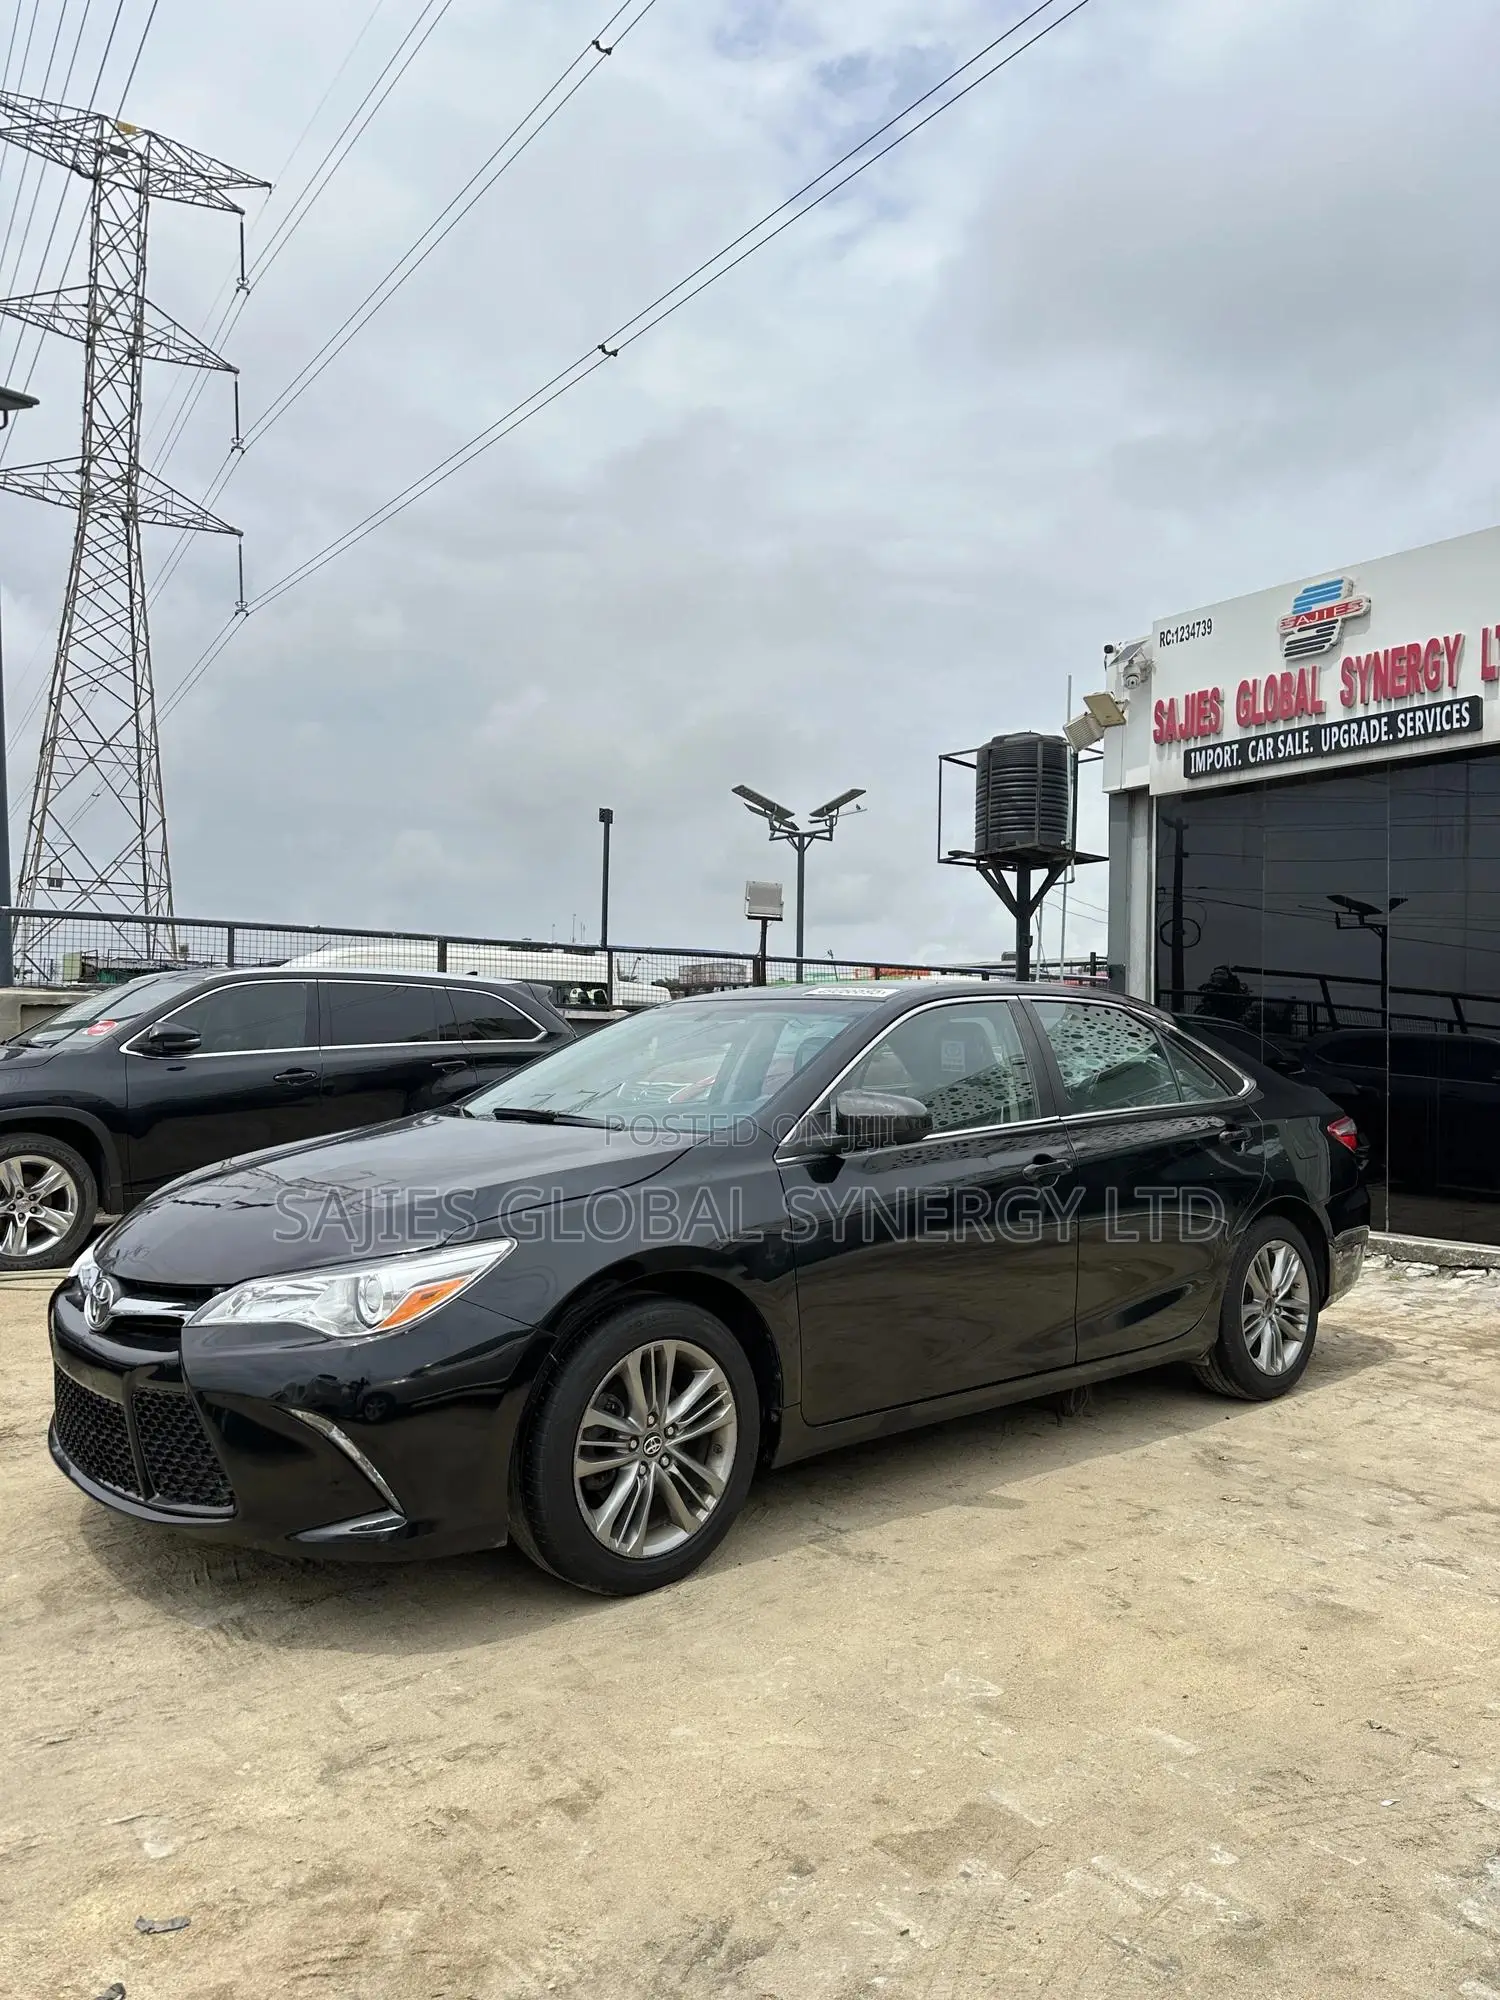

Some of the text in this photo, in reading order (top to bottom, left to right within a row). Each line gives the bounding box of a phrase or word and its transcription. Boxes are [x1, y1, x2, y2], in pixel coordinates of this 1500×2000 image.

[1159, 618, 1213, 648] RC:1234739
[1280, 598, 1364, 631] SAJIES
[1153, 625, 1500, 745] SAJIES GLOBAL SYNERGY L
[1190, 701, 1470, 774] IMPORT. CAR SALE. UPGRADE. SERVICES
